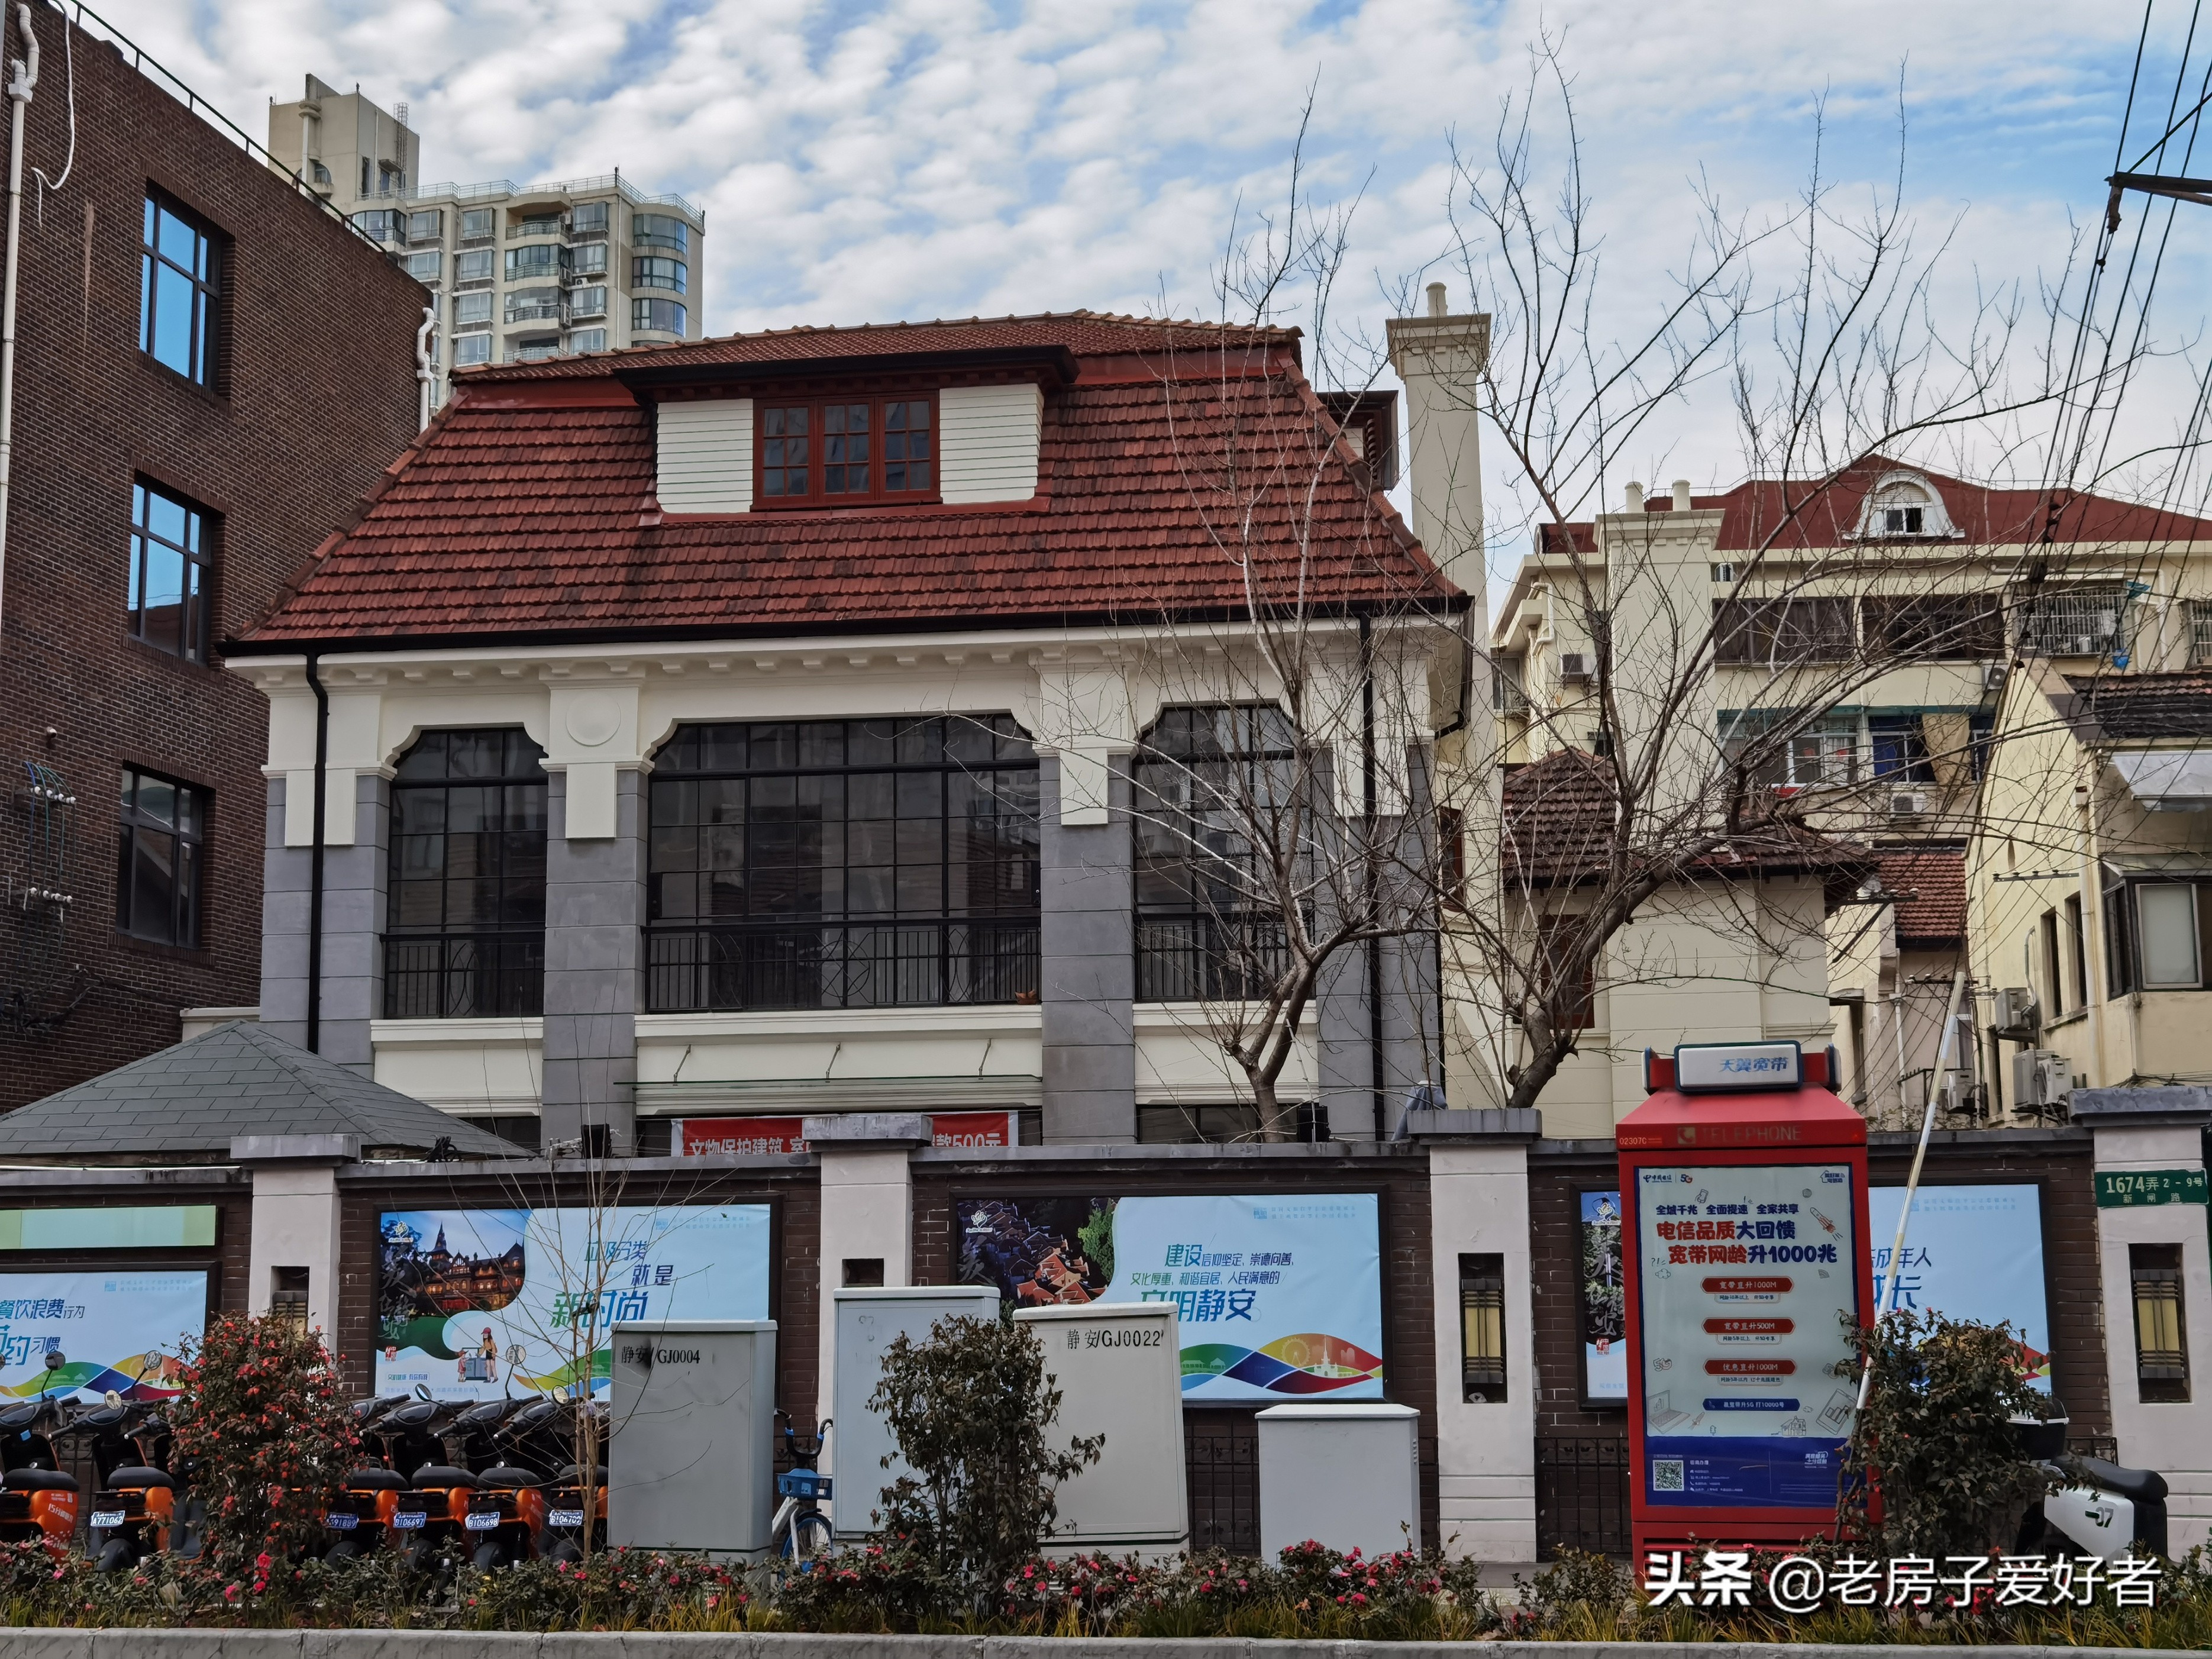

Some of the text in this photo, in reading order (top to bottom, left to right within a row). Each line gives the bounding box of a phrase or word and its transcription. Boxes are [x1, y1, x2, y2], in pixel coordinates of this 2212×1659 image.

[1719, 1057, 1788, 1073] 天翼宽带
[932, 1133, 1001, 1147] 款500元
[1703, 1125, 1802, 1144] TELEPHONE
[690, 1137, 811, 1154] 文物保护建筑 室
[2106, 1176, 2159, 1193] 1674弄
[2123, 1193, 2181, 1203] 新闸路
[1656, 1203, 1800, 1215] 全城千兆 全面提速 全家共享
[1656, 1220, 1796, 1240] 电信品质大回馈
[584, 1240, 648, 1262] 垃圾分类
[1668, 1244, 1838, 1264] 宽带网龄升1000兆
[631, 1264, 674, 1286] 就是
[549, 1290, 648, 1328] 新时尚
[92, 1516, 123, 1525] A771062
[469, 1518, 498, 1528] B106698
